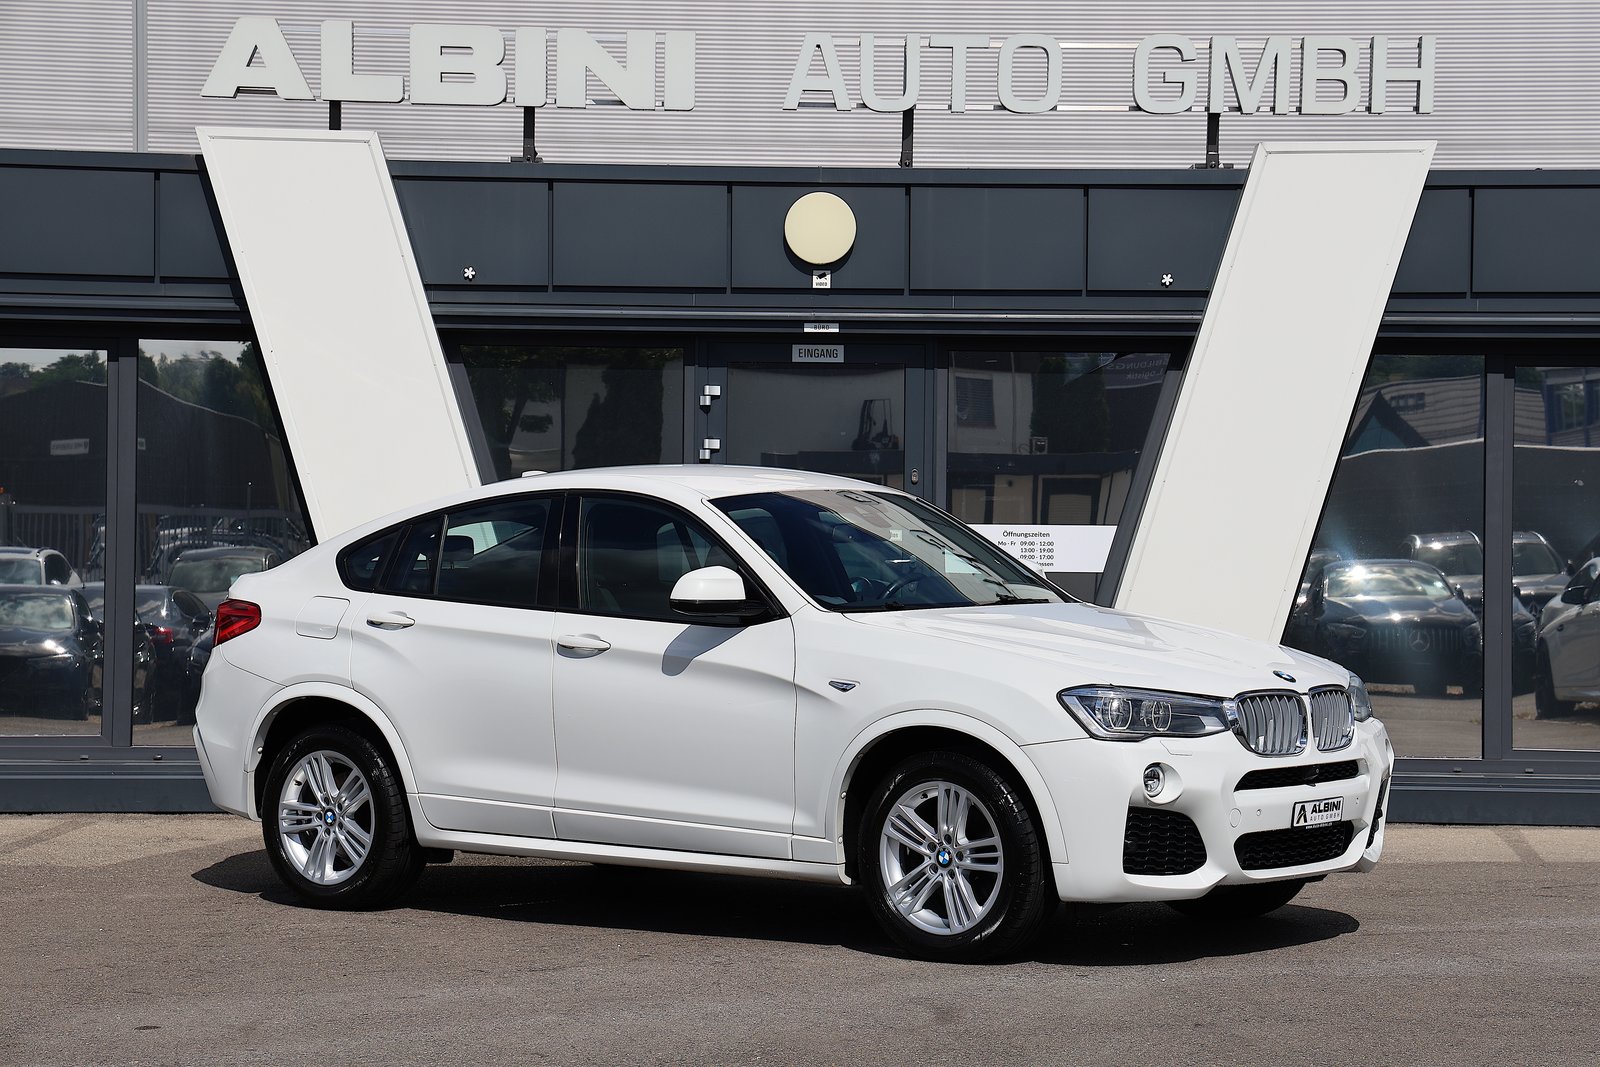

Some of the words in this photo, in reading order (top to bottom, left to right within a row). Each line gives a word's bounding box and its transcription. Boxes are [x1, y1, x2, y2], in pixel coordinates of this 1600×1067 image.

[200, 16, 697, 111] ALBINI
[781, 32, 1063, 114] AUTO
[1131, 33, 1437, 116] GMBH
[798, 348, 838, 359] EINGANG
[1310, 800, 1341, 814] ALBINI
